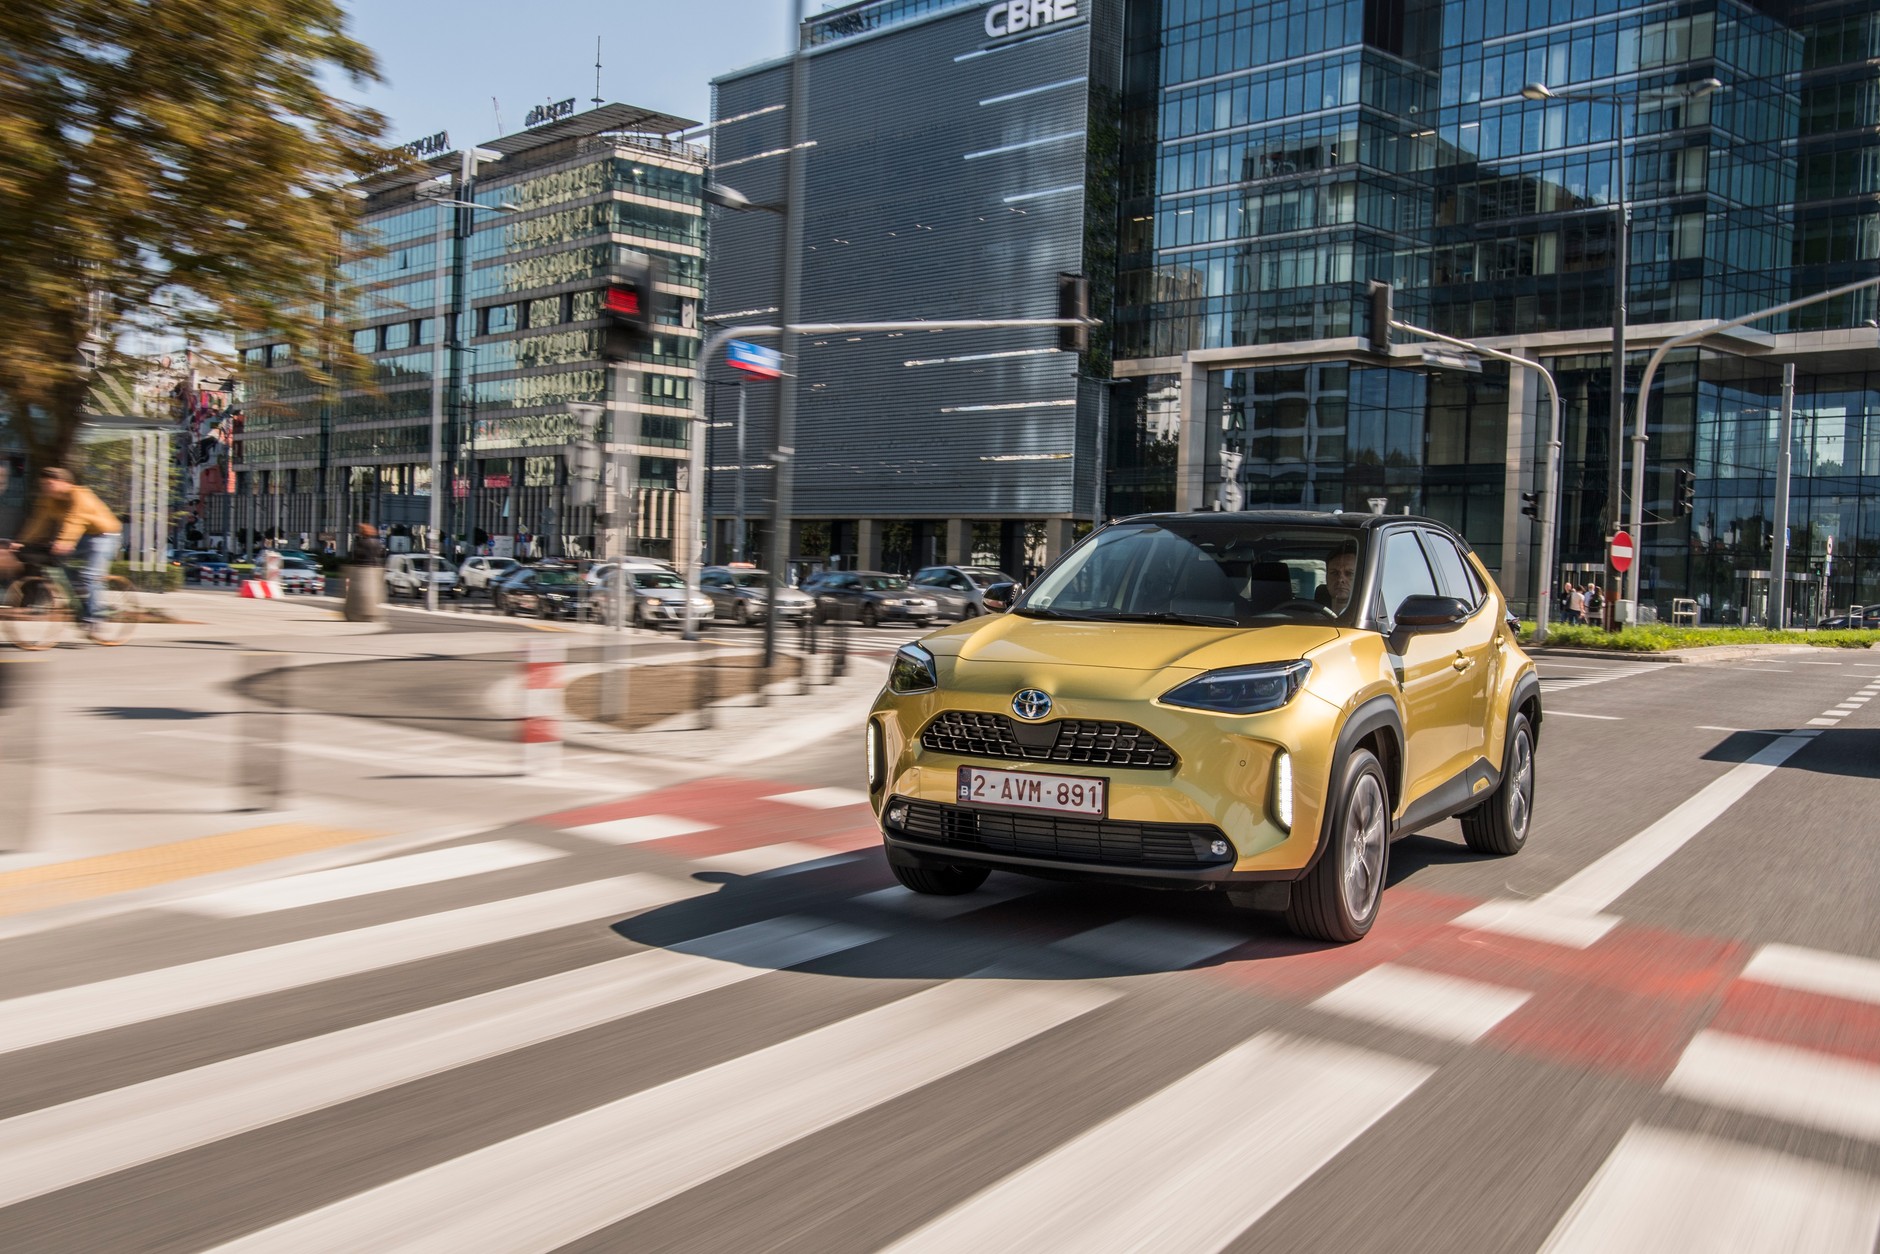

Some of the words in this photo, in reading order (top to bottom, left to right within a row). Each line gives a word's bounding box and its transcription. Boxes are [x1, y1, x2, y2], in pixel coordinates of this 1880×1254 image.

[985, 0, 1077, 37] CBRE
[960, 786, 969, 796] B
[973, 775, 1096, 808] 2-AVM-891
